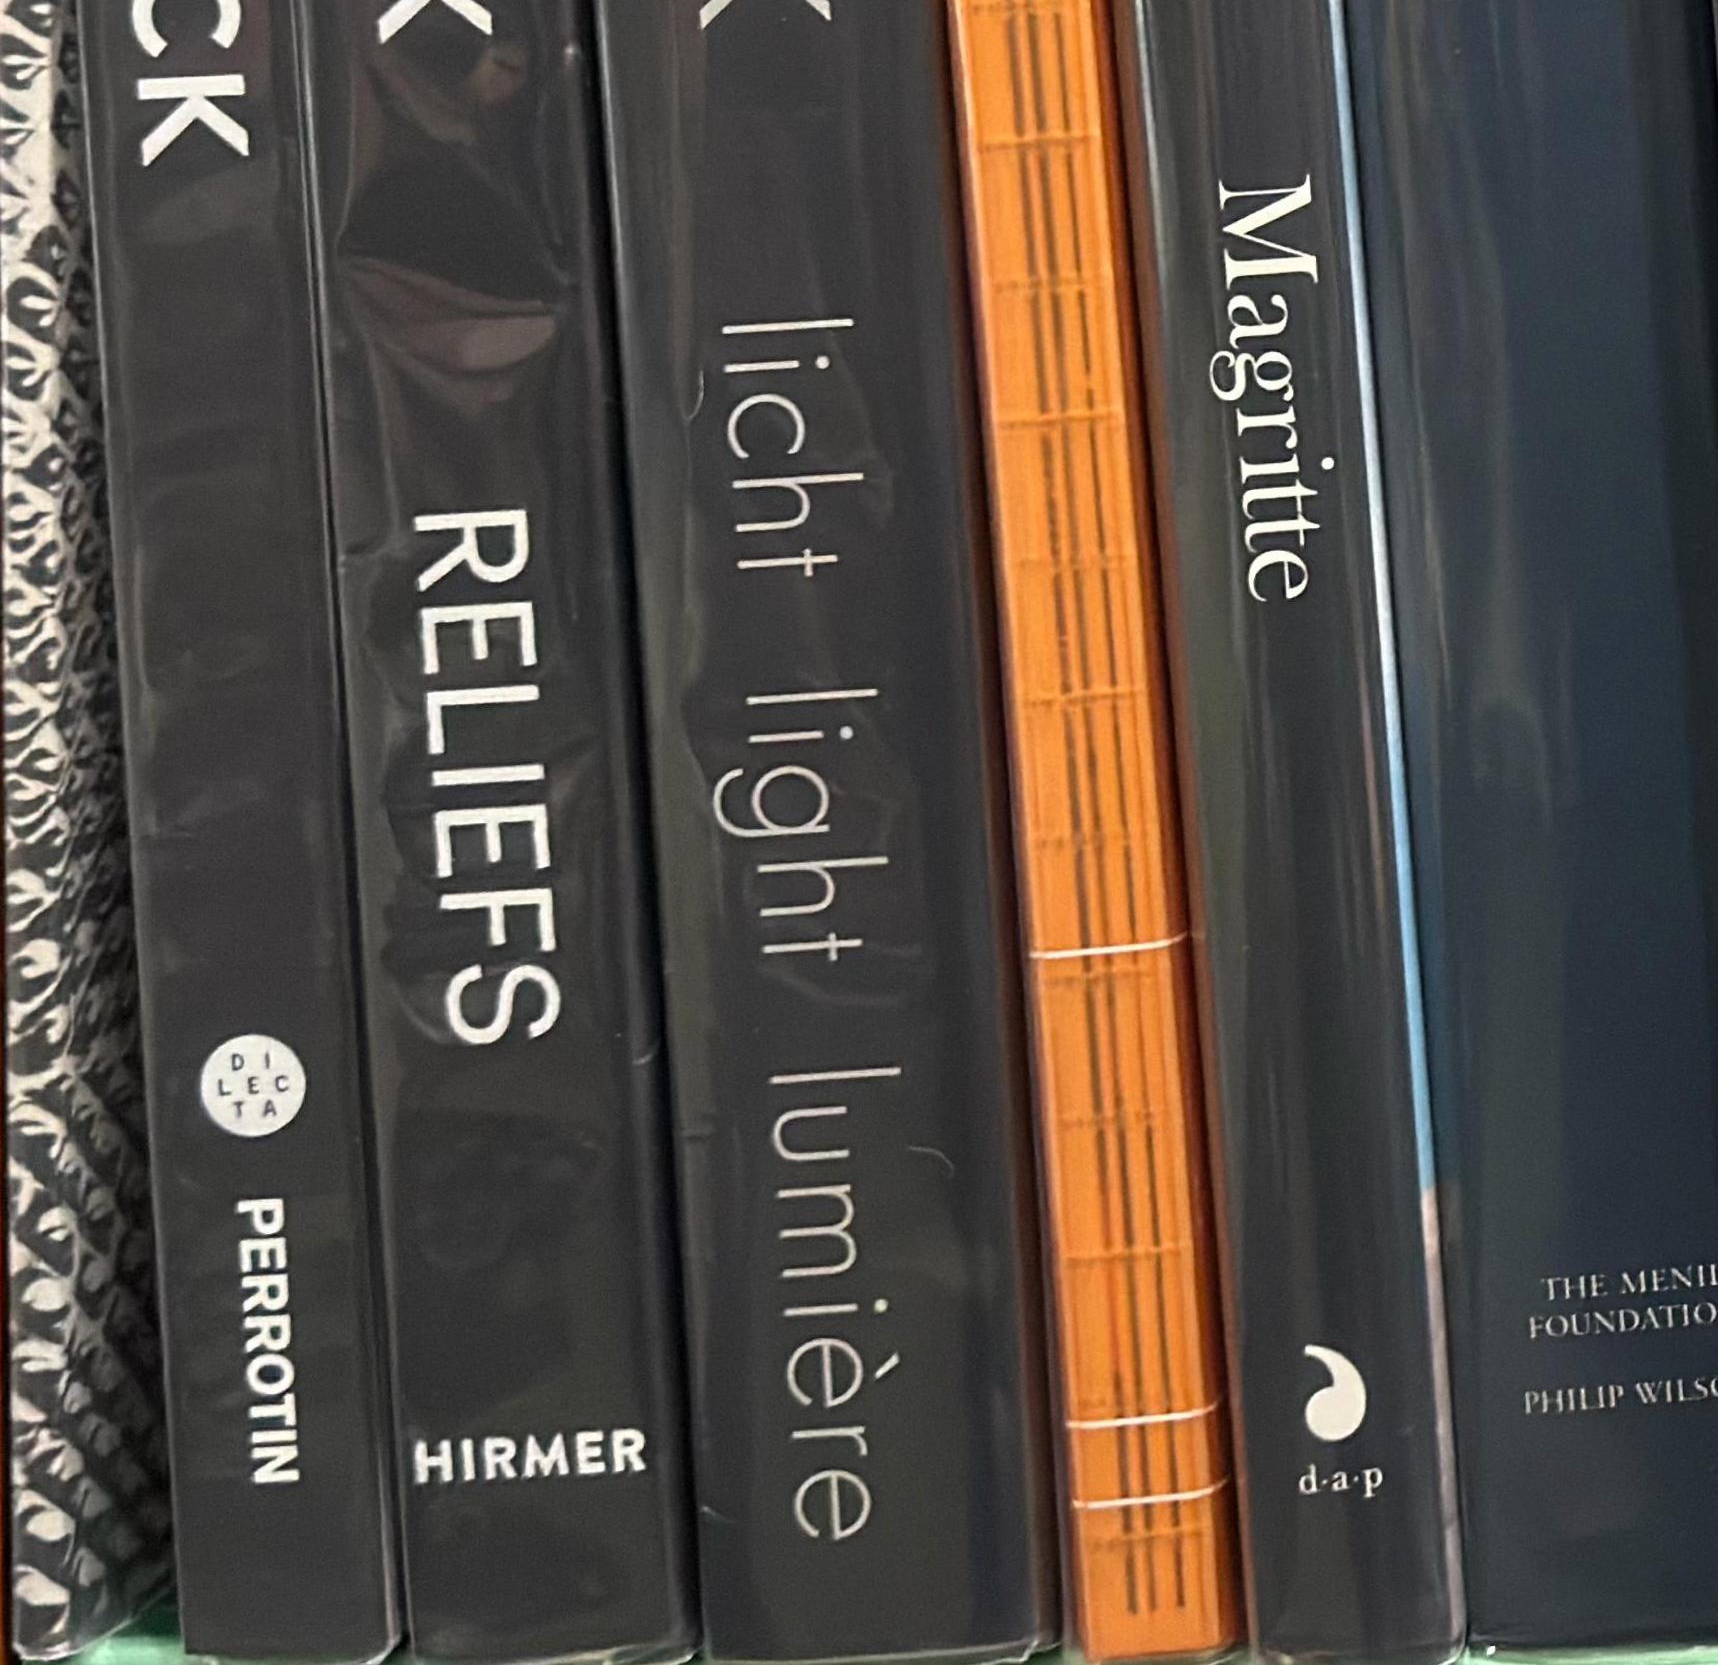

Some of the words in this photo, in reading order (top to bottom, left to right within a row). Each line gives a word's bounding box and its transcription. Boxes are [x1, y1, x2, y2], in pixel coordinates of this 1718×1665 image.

[722, 318, 864, 576] licht
[1209, 174, 1335, 603] Magritte
[413, 507, 562, 1044] RELIEFS
[713, 688, 889, 961] light
[236, 1197, 300, 1485] PERROTIN
[769, 1067, 902, 1540] lumière
[1524, 1384, 1624, 1416] PHILIP
[1541, 1275, 1606, 1302] THE
[413, 1428, 647, 1486] HIRMER
